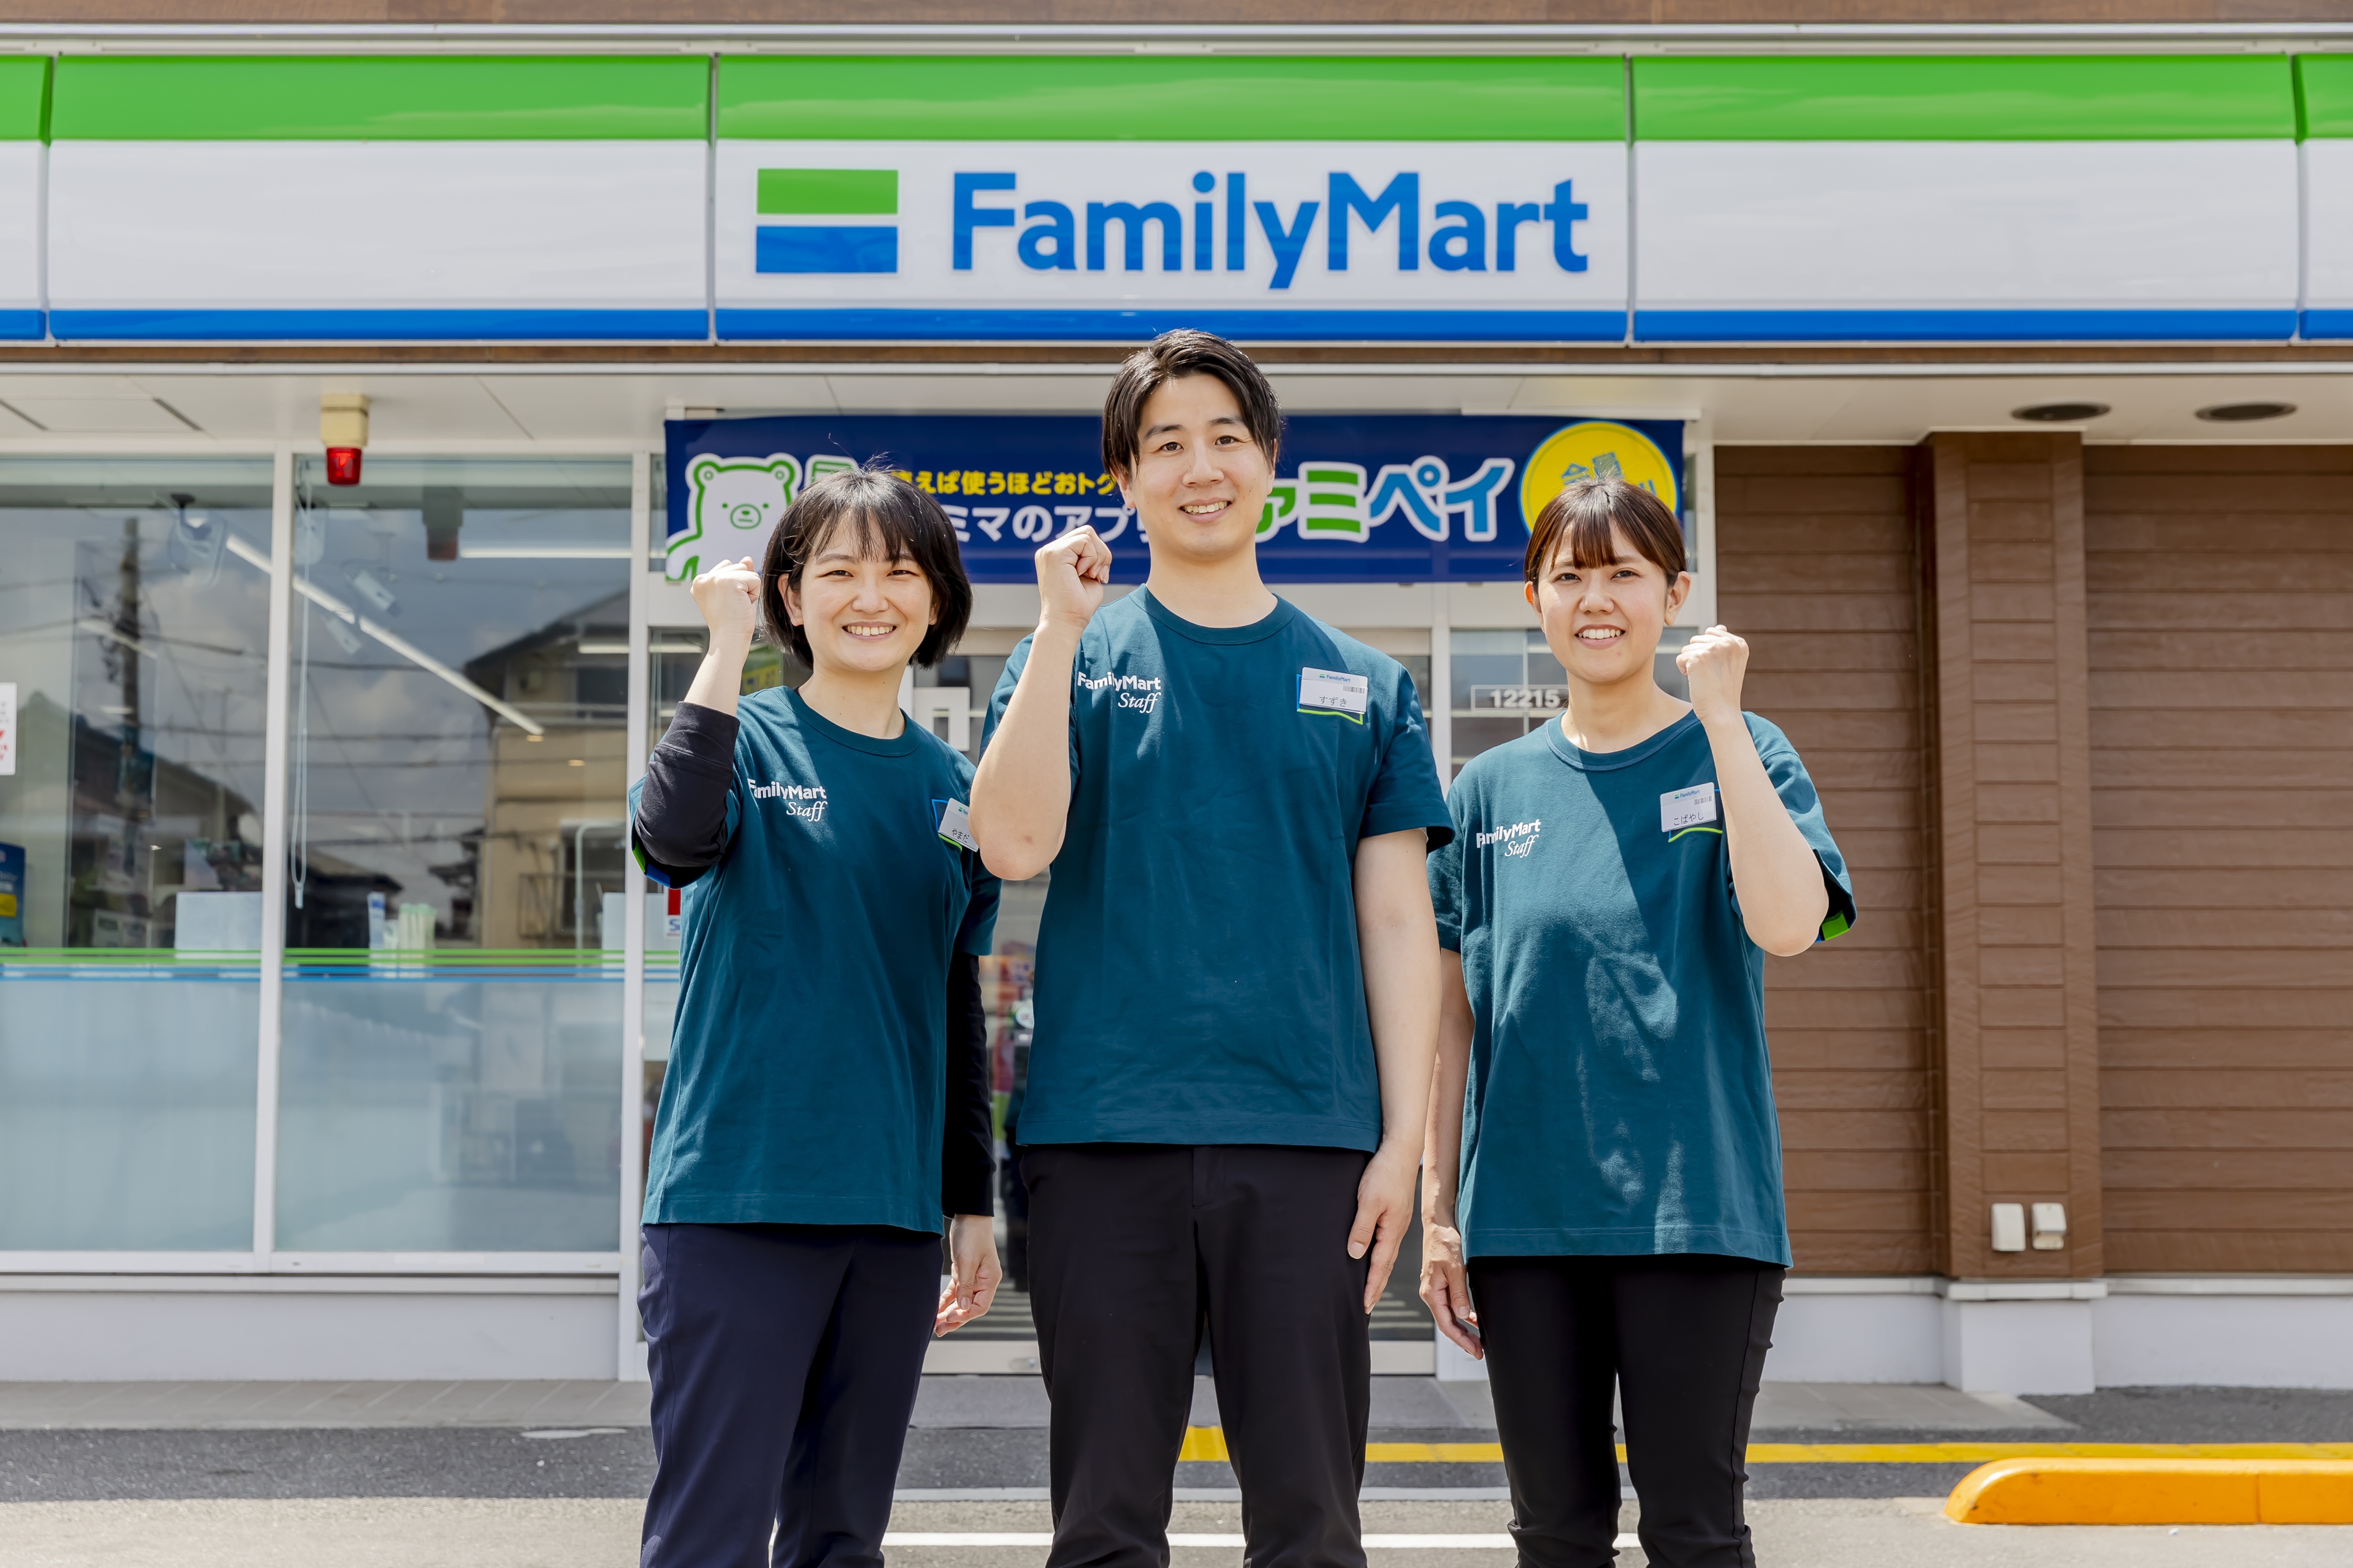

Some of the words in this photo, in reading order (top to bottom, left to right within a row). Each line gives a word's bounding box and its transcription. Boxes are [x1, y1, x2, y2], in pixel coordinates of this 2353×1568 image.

[952, 170, 1589, 290] FamilyMart
[891, 469, 1116, 495] えば使うほどおトク
[1077, 671, 1162, 691] FamilyMart
[1118, 692, 1162, 714] Staff
[1319, 695, 1347, 707] すずき
[1490, 688, 1560, 708] 12215
[747, 777, 827, 800] FamilyMart
[1680, 789, 1700, 798] FamilyMart
[786, 801, 828, 823] Staff
[1674, 812, 1704, 826] こばやし
[951, 827, 970, 843] やまだ
[1476, 818, 1541, 849] FamilyMart
[1504, 834, 1539, 858] Staff
